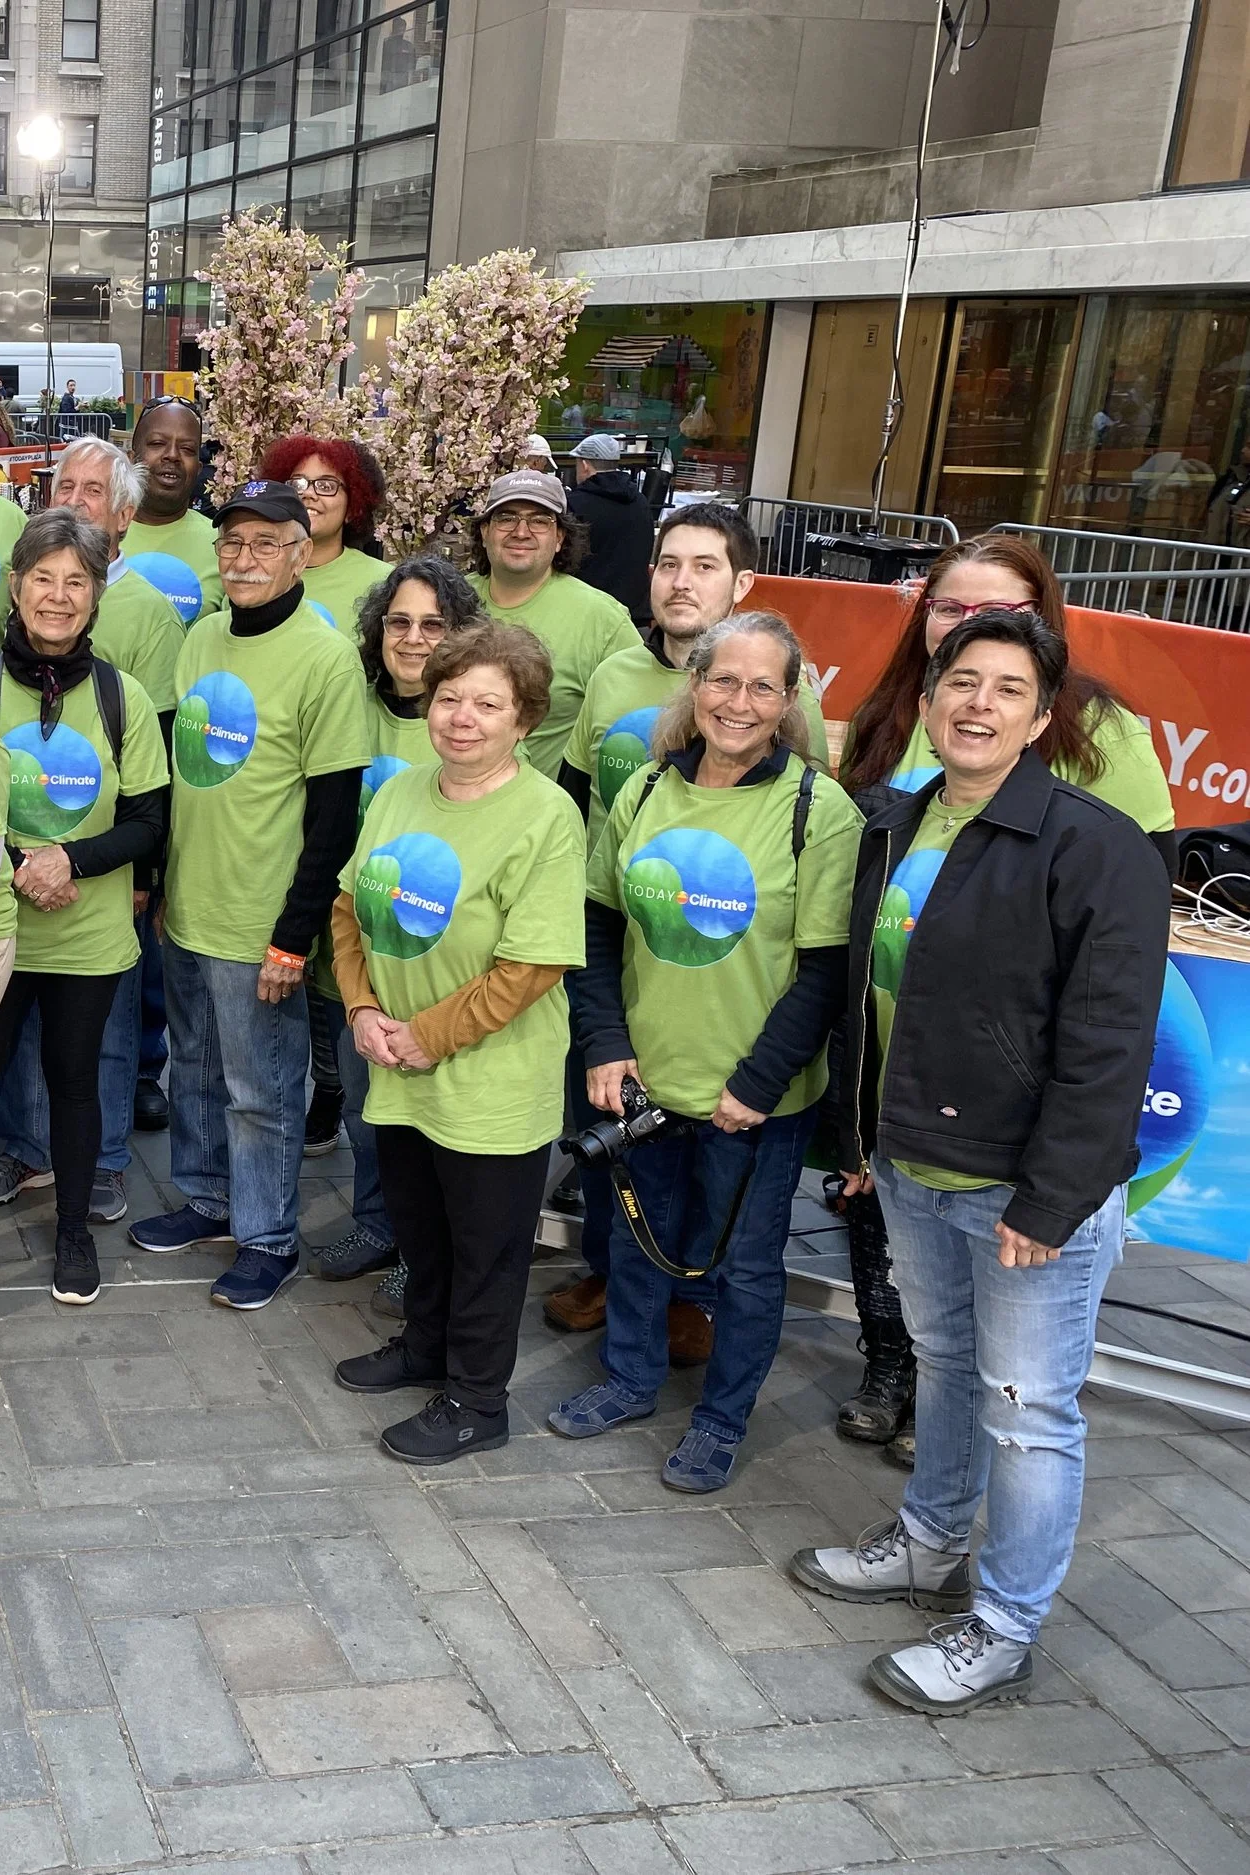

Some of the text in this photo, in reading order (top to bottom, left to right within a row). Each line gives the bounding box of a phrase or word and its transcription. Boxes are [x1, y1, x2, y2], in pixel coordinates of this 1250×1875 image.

[147, 230, 159, 310] COFFEE
[178, 716, 249, 743] TODAY Climate
[602, 755, 641, 771] TODAY
[10, 774, 96, 785] DAY Climate
[358, 875, 446, 915] TODAY Climate
[628, 883, 748, 912] TODAY Climate
[621, 1189, 639, 1219] Nikon
